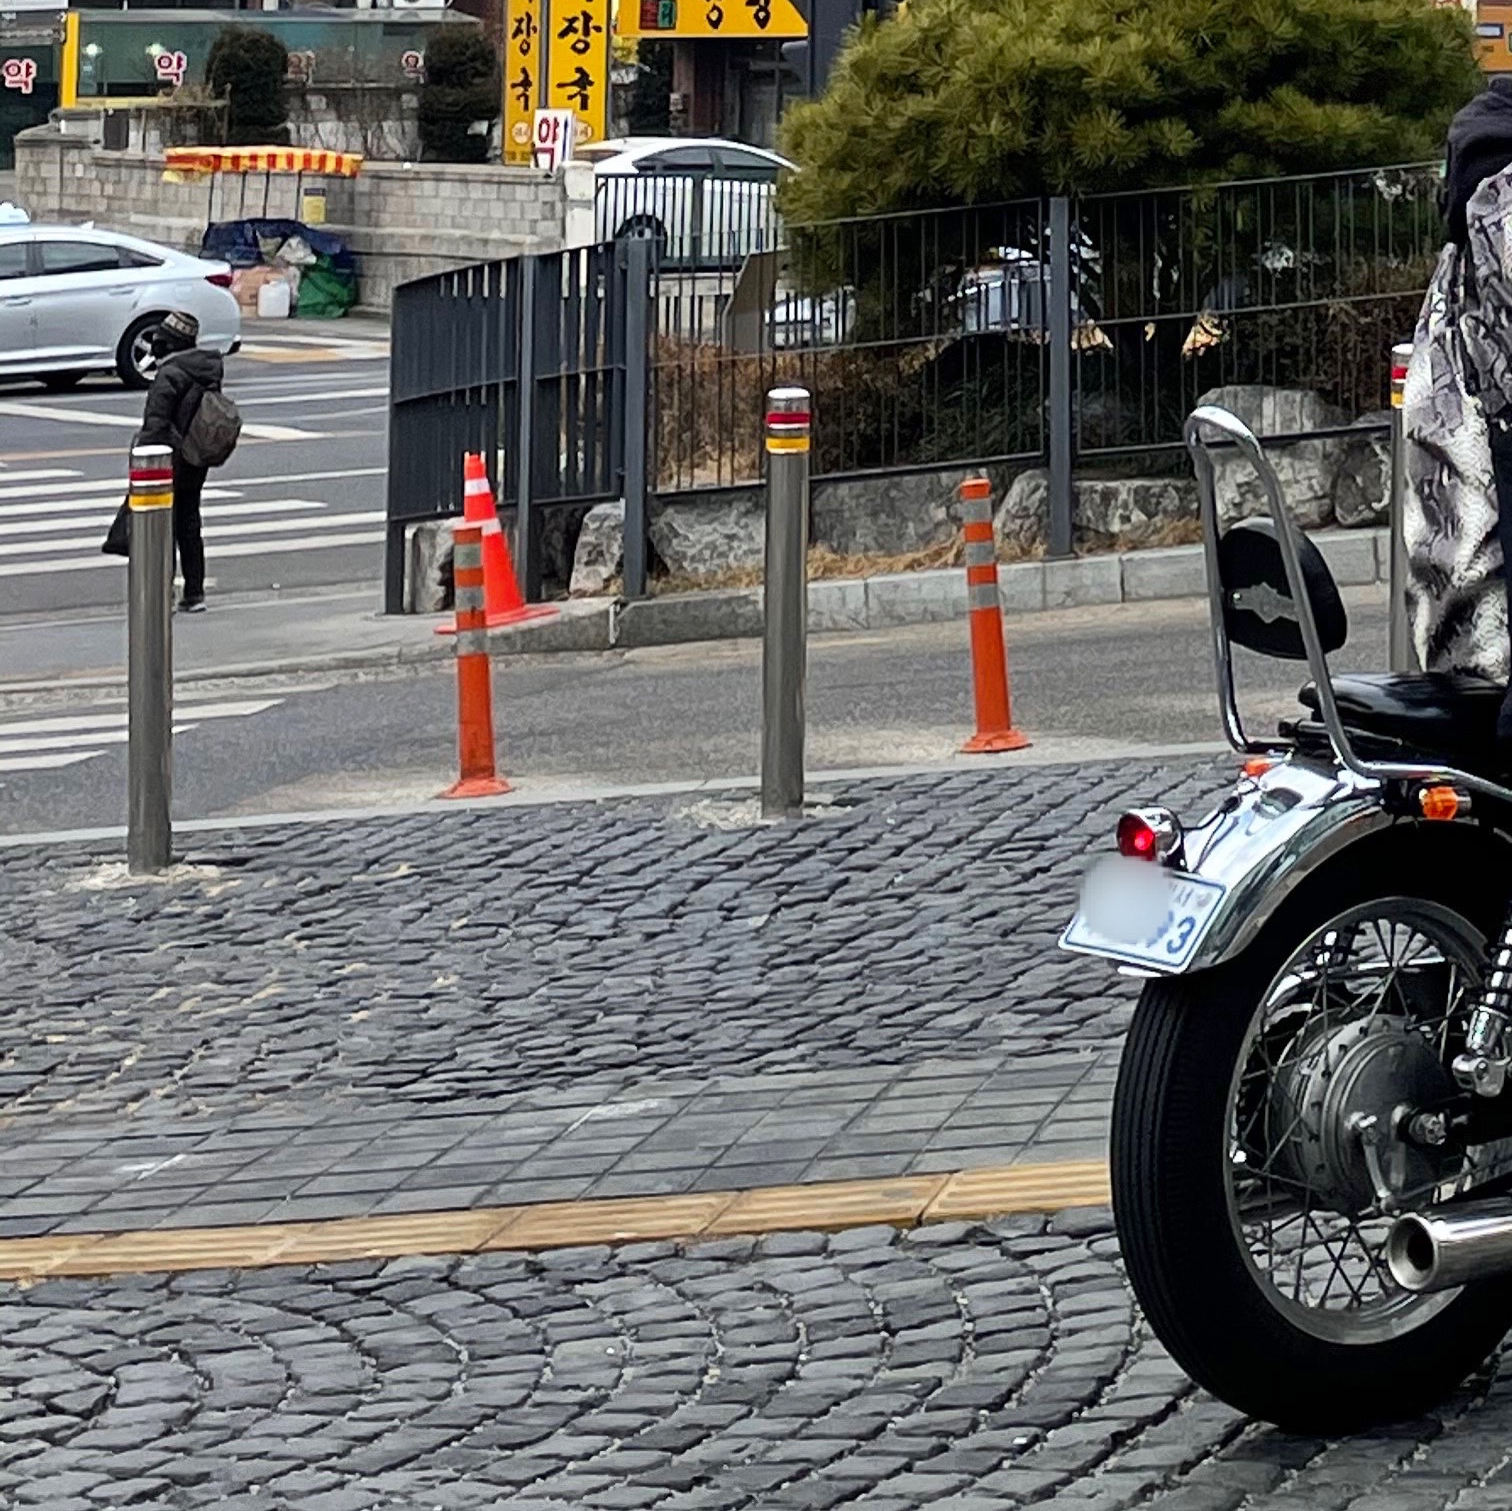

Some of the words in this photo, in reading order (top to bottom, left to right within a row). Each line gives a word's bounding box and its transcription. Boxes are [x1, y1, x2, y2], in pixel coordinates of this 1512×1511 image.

[4, 59, 36, 92] 약
[155, 51, 187, 86] 약
[534, 116, 561, 173] 약
